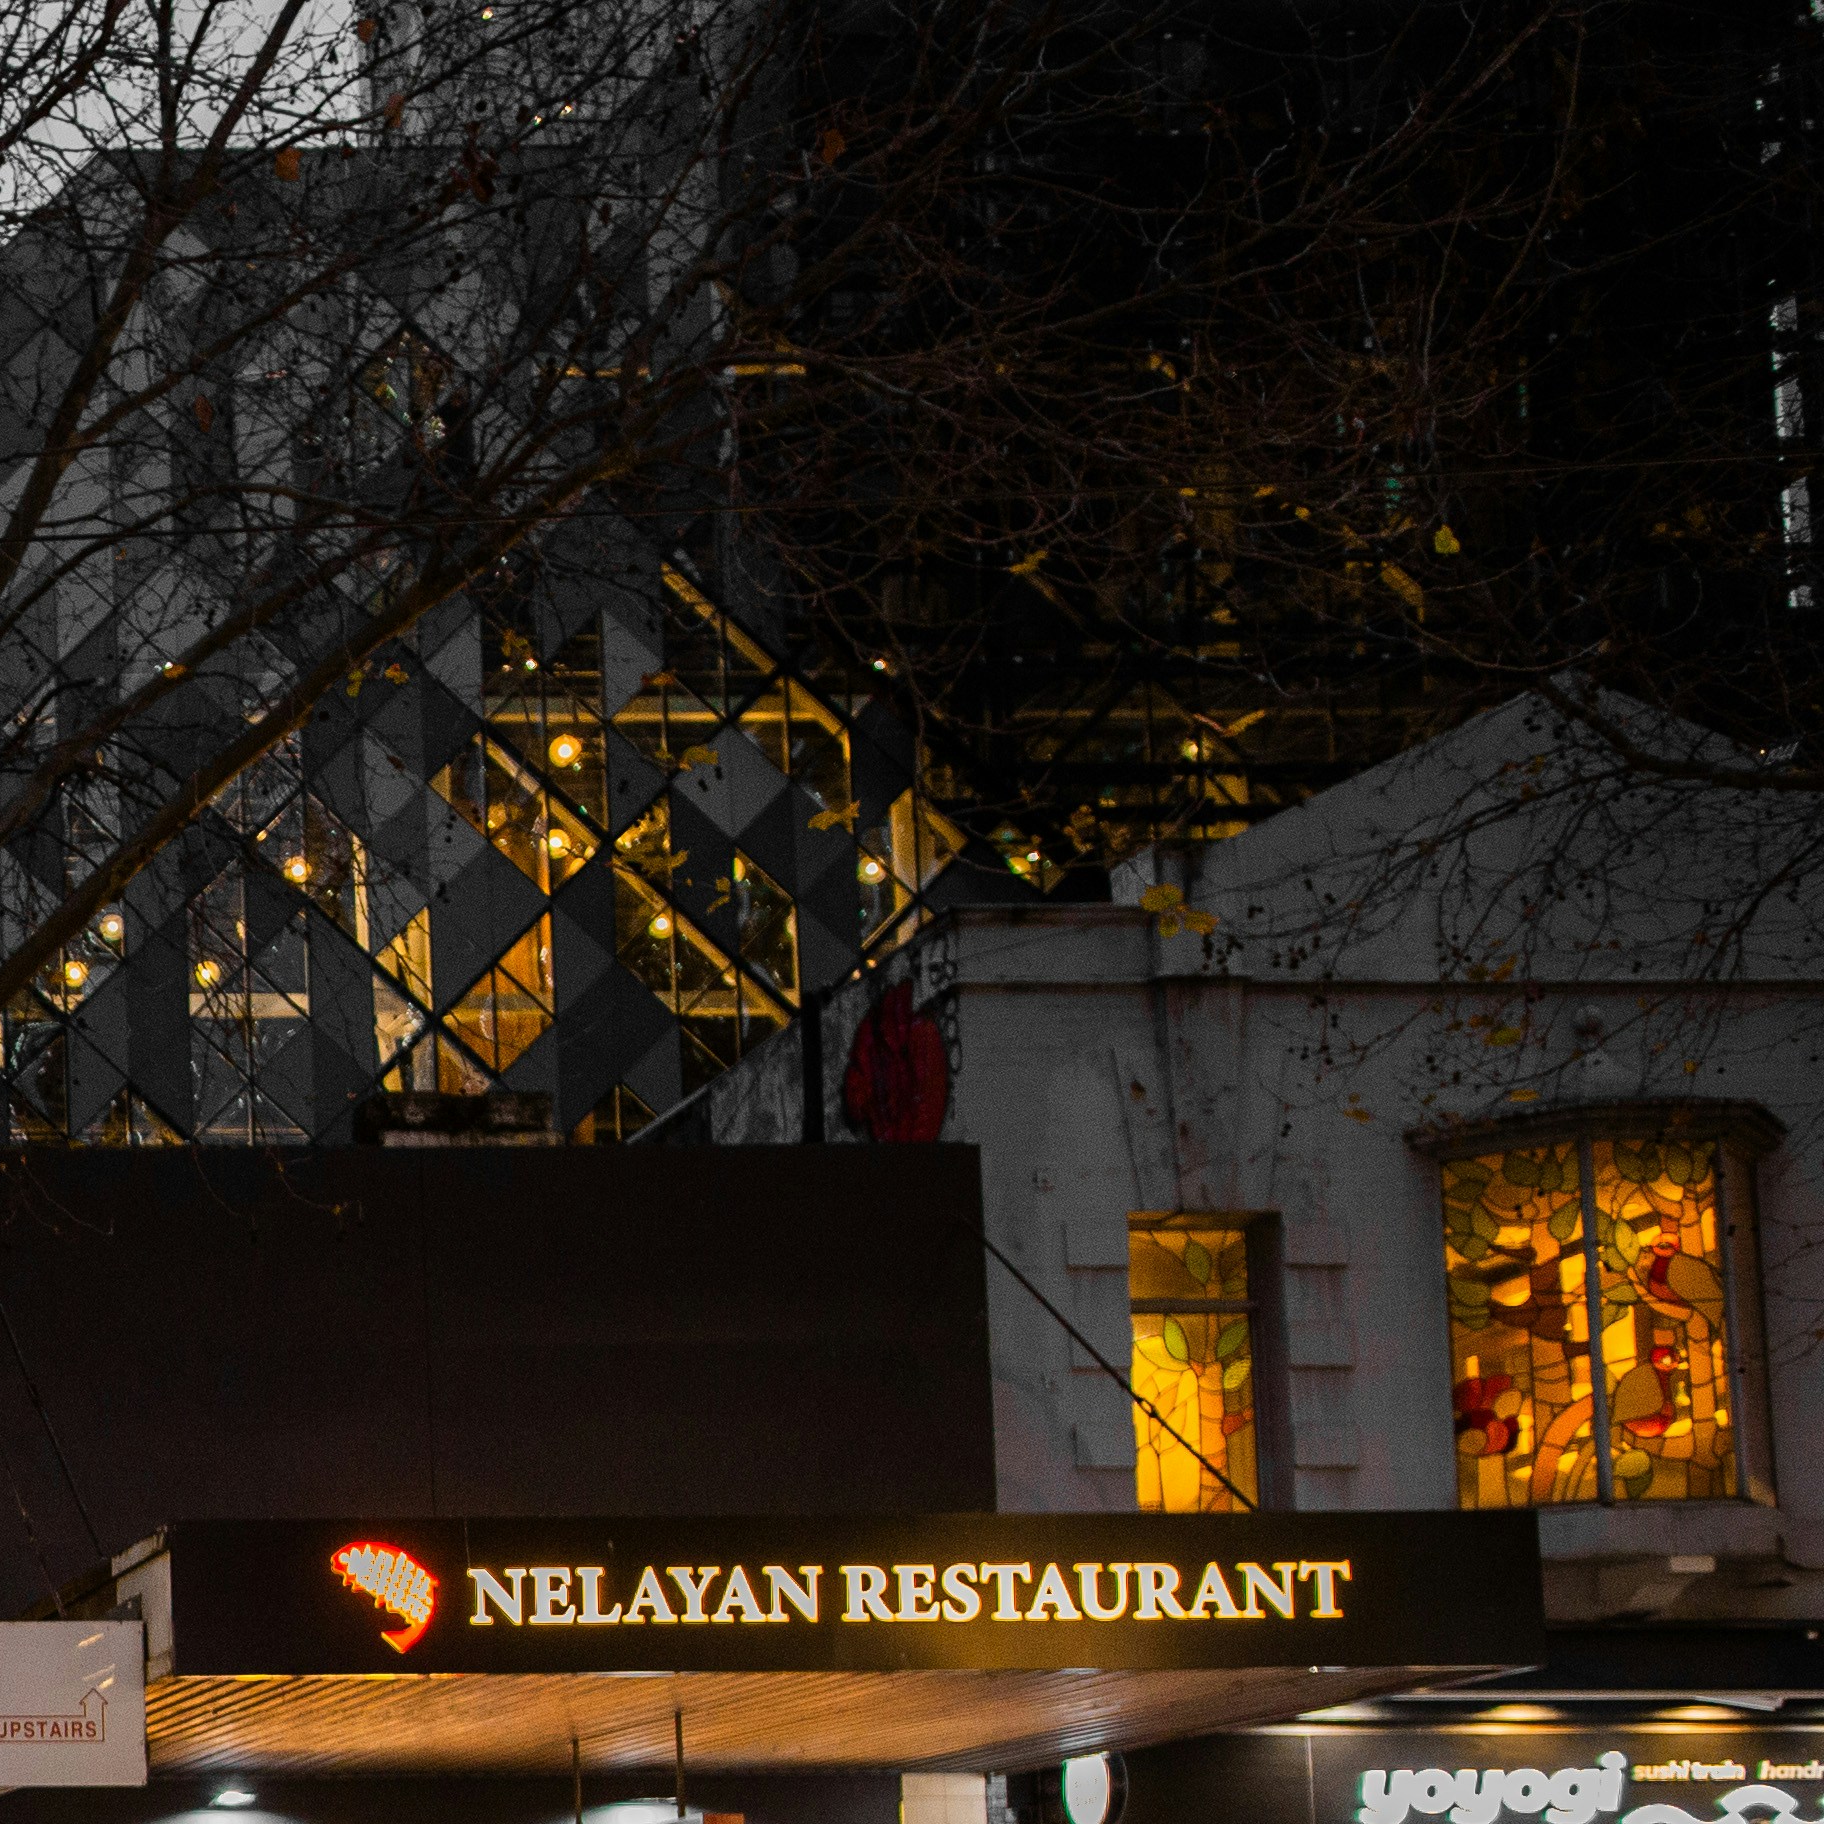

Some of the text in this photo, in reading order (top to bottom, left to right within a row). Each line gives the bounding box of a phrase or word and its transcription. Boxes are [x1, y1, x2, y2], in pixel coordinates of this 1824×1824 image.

[469, 1559, 1351, 1626] NELAYAN RESTAURANT
[1632, 1760, 1824, 1781] sushi train handr
